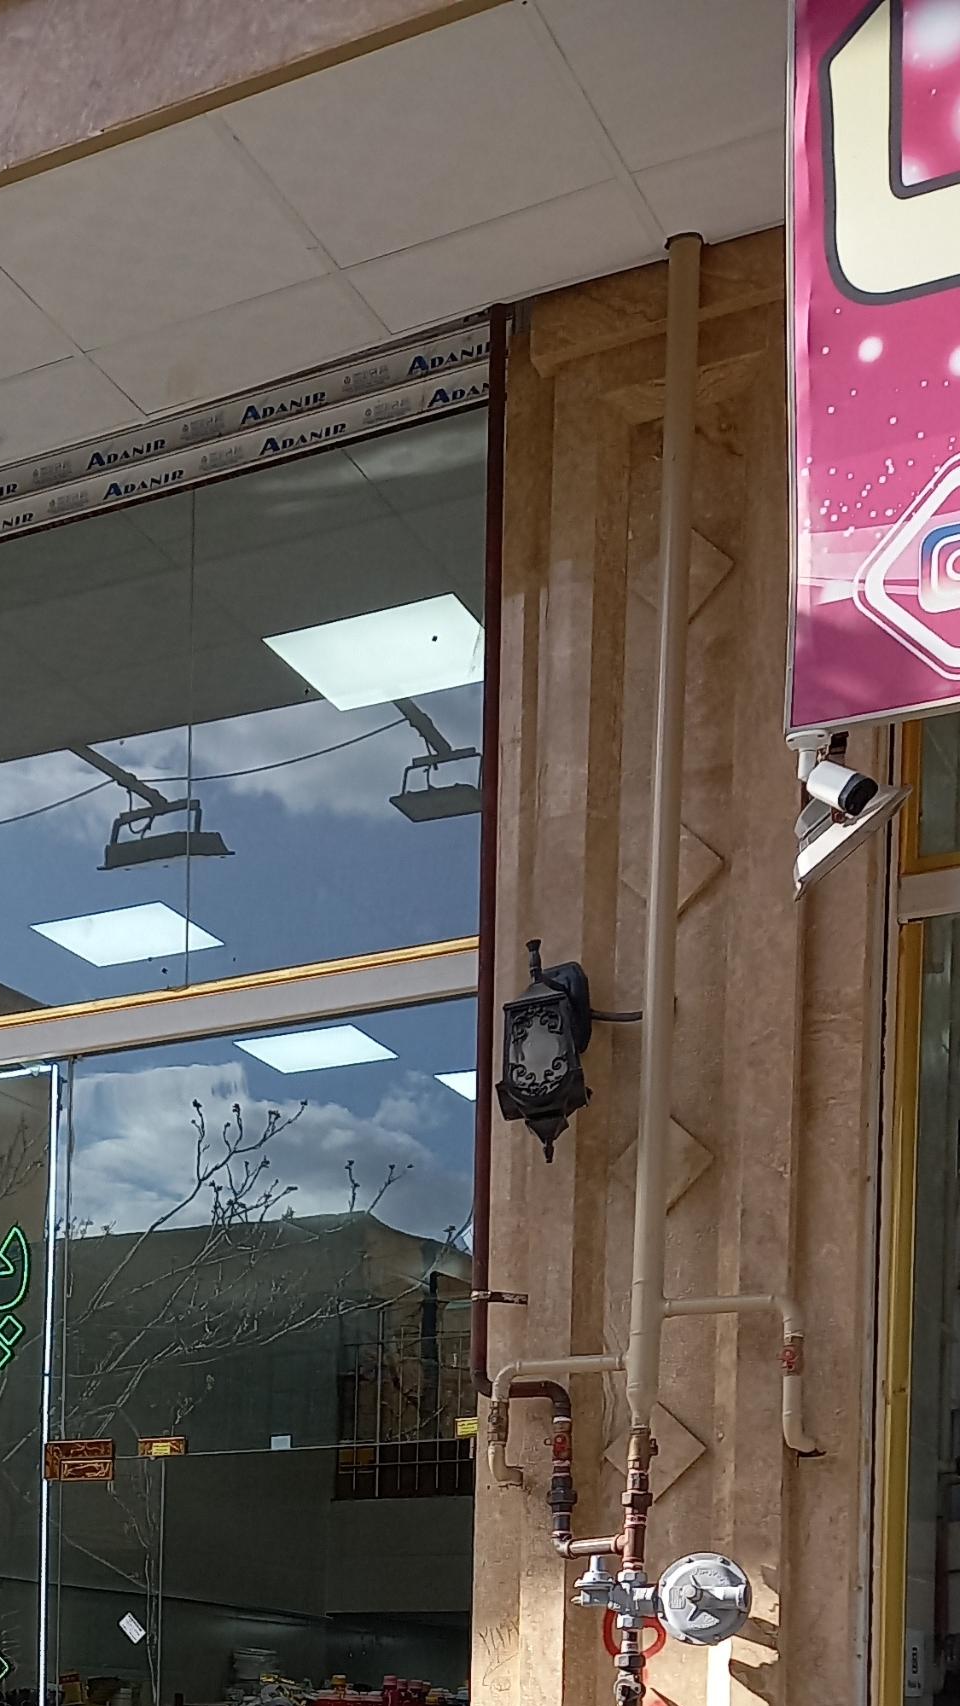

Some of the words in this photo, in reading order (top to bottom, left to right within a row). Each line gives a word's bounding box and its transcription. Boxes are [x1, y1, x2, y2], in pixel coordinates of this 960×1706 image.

[86, 438, 166, 471] ADANIR
[240, 391, 327, 425] ADANIR
[407, 341, 490, 376] ADANI
[103, 469, 184, 500] ADANIR
[258, 423, 347, 456] ADANIR
[426, 382, 490, 409] ADAN
